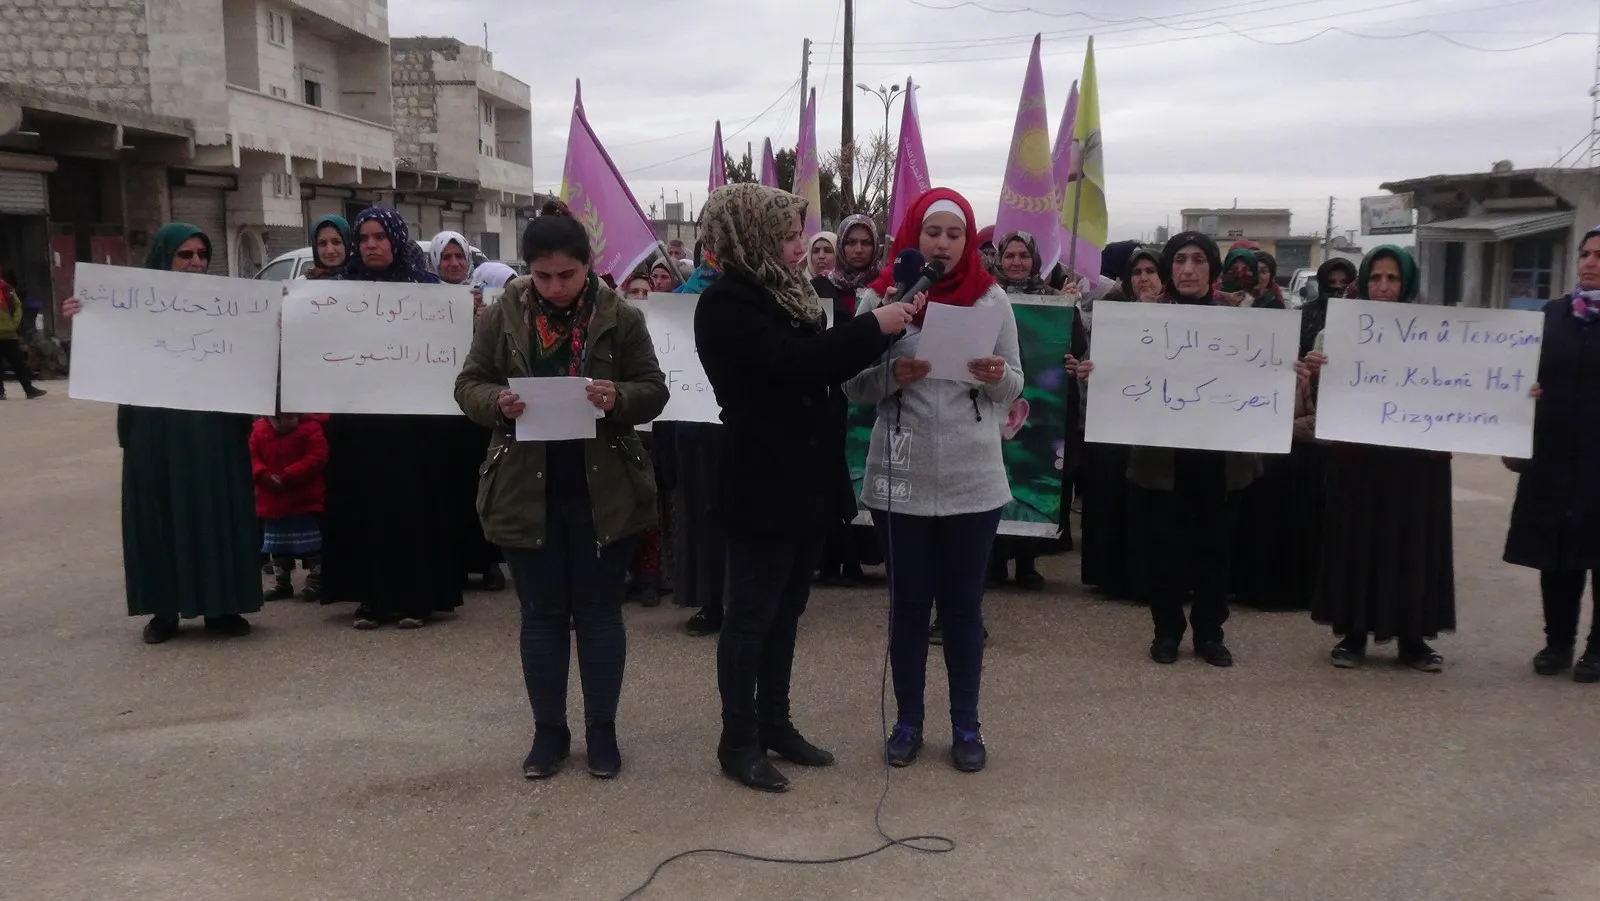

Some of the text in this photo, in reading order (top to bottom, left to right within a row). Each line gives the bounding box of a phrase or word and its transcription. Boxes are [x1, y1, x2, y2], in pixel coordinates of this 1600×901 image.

[247, 299, 270, 313] لا
[311, 296, 338, 314] هو
[1141, 322, 1198, 360] المرأة
[1358, 313, 1384, 344] Bi
[1395, 316, 1428, 343] Vin
[1485, 367, 1525, 393] Hat
